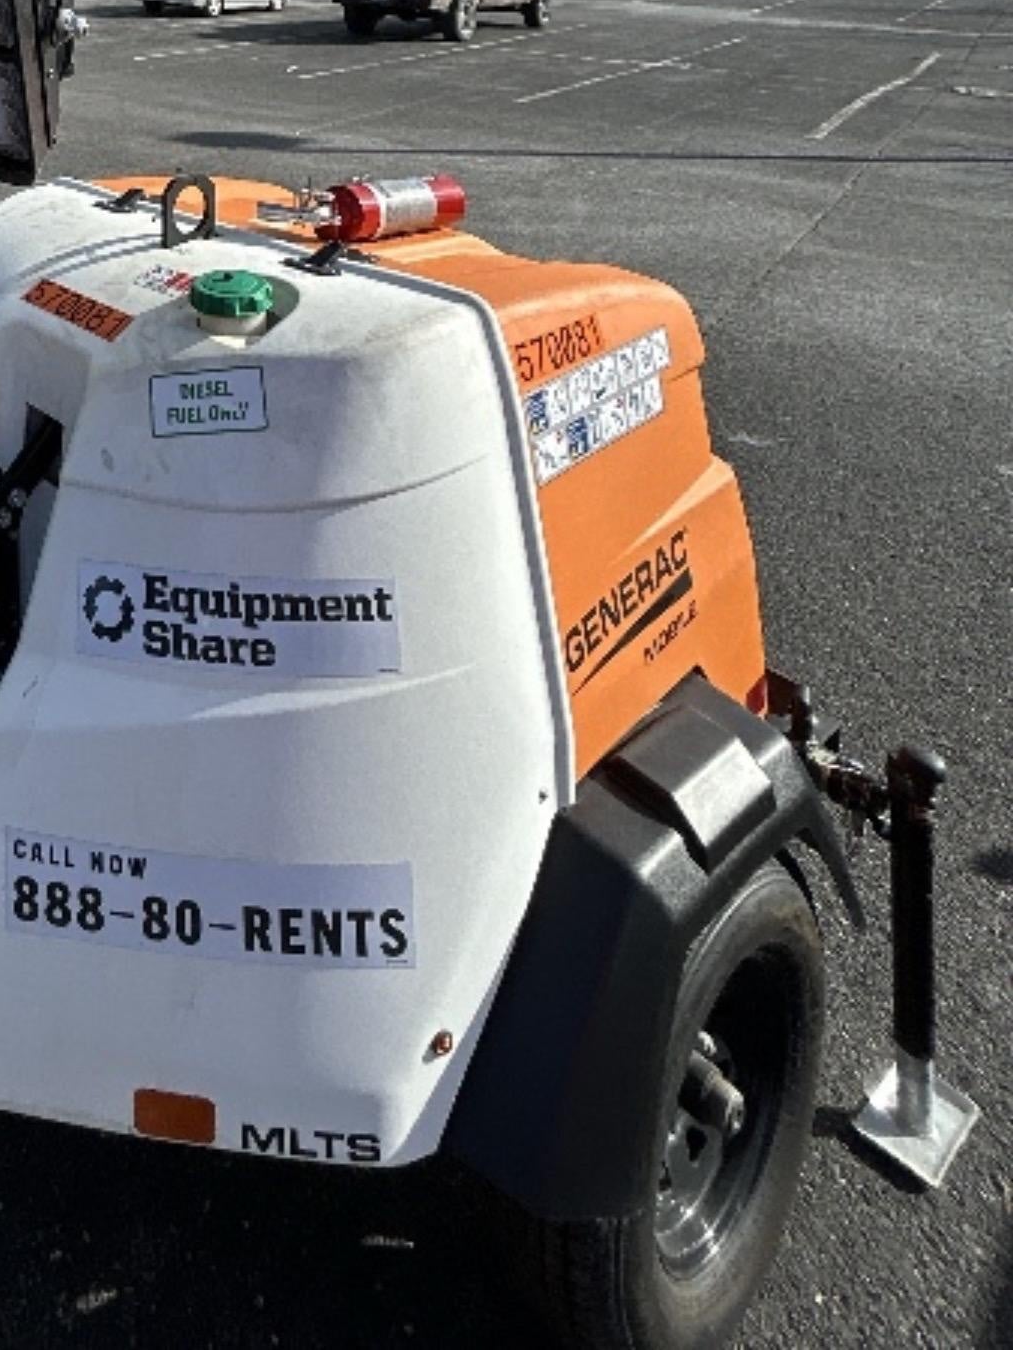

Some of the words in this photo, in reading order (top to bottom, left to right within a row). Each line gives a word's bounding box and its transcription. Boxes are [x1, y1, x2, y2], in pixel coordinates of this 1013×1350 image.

[514, 314, 601, 382] 570081
[167, 406, 206, 425] FUEL
[208, 402, 249, 422] ONLY
[179, 380, 234, 400] DIESEL
[142, 573, 393, 630] Equipment
[565, 528, 688, 673] GENERAC
[142, 620, 276, 667] Share
[13, 839, 75, 868] CALL
[91, 851, 147, 879] NOW
[13, 876, 408, 958] 888-80-RENTS
[241, 1123, 381, 1162] MLTS
